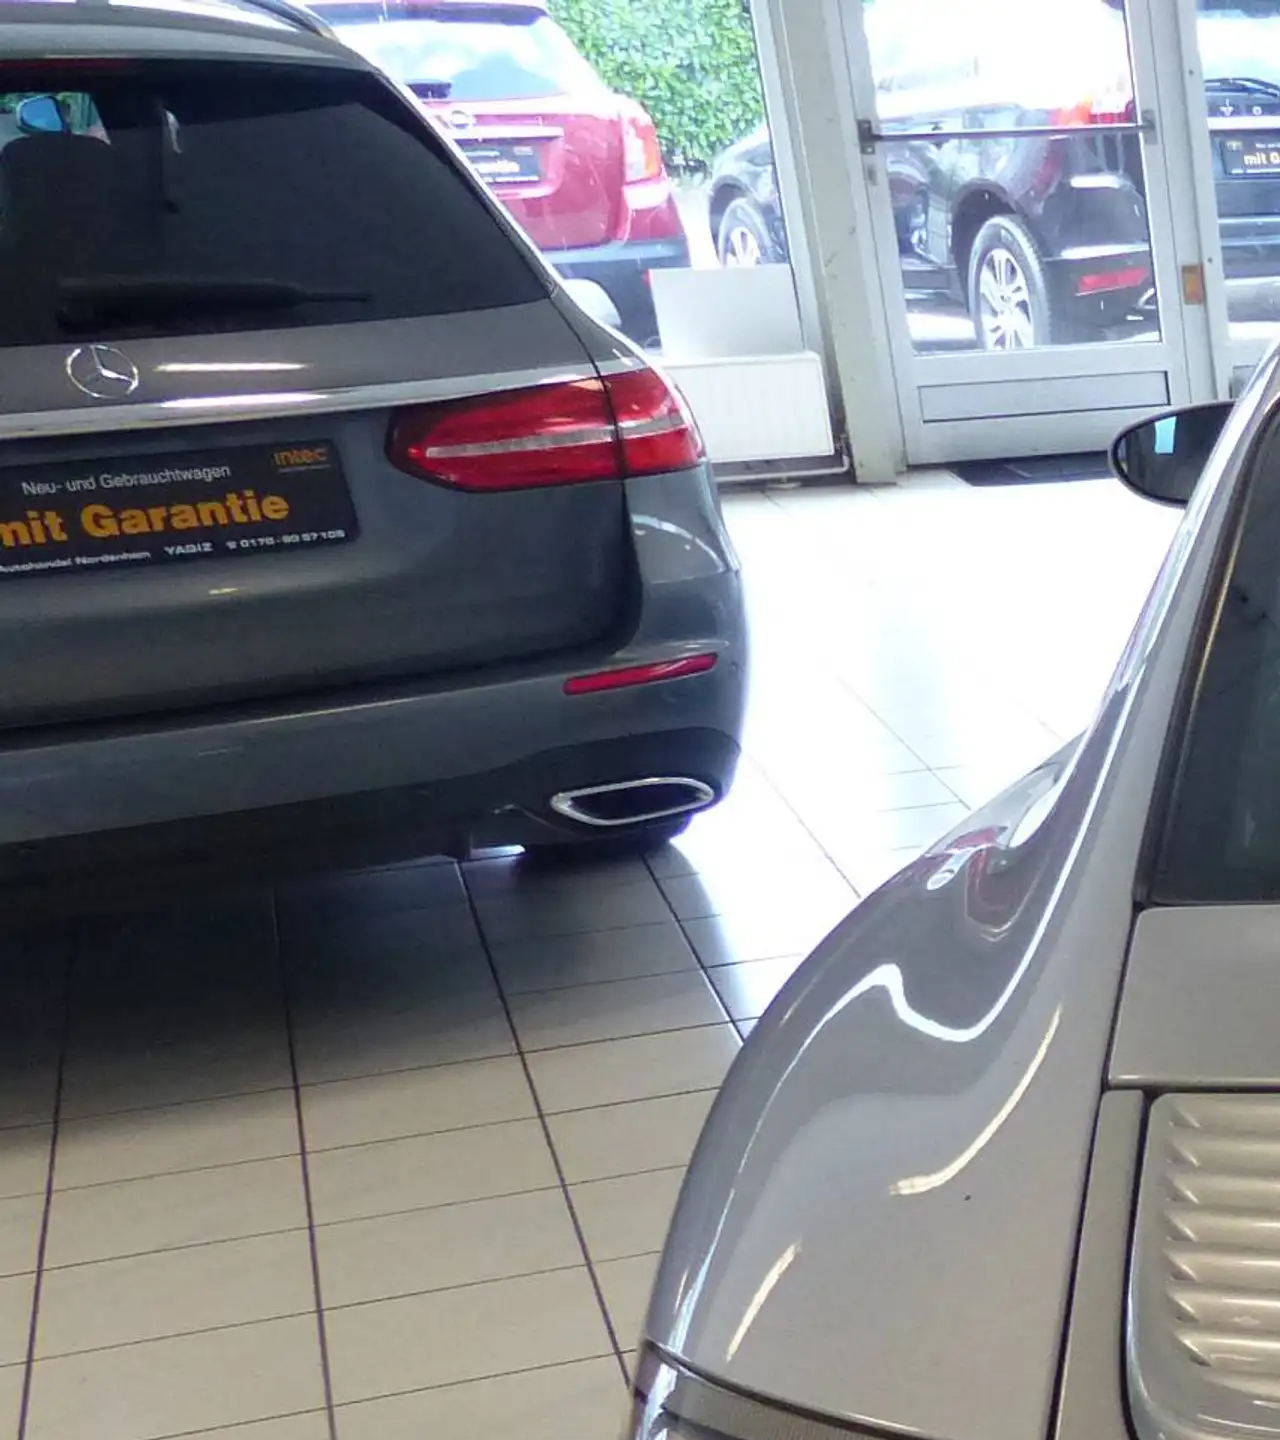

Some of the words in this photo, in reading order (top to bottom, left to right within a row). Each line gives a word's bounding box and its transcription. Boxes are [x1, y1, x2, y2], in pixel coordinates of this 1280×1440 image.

[274, 447, 328, 466] intec
[20, 479, 63, 496] Neu-
[66, 475, 97, 492] und
[100, 464, 231, 489] Gebrauchtwagen
[81, 488, 290, 538] Garantie
